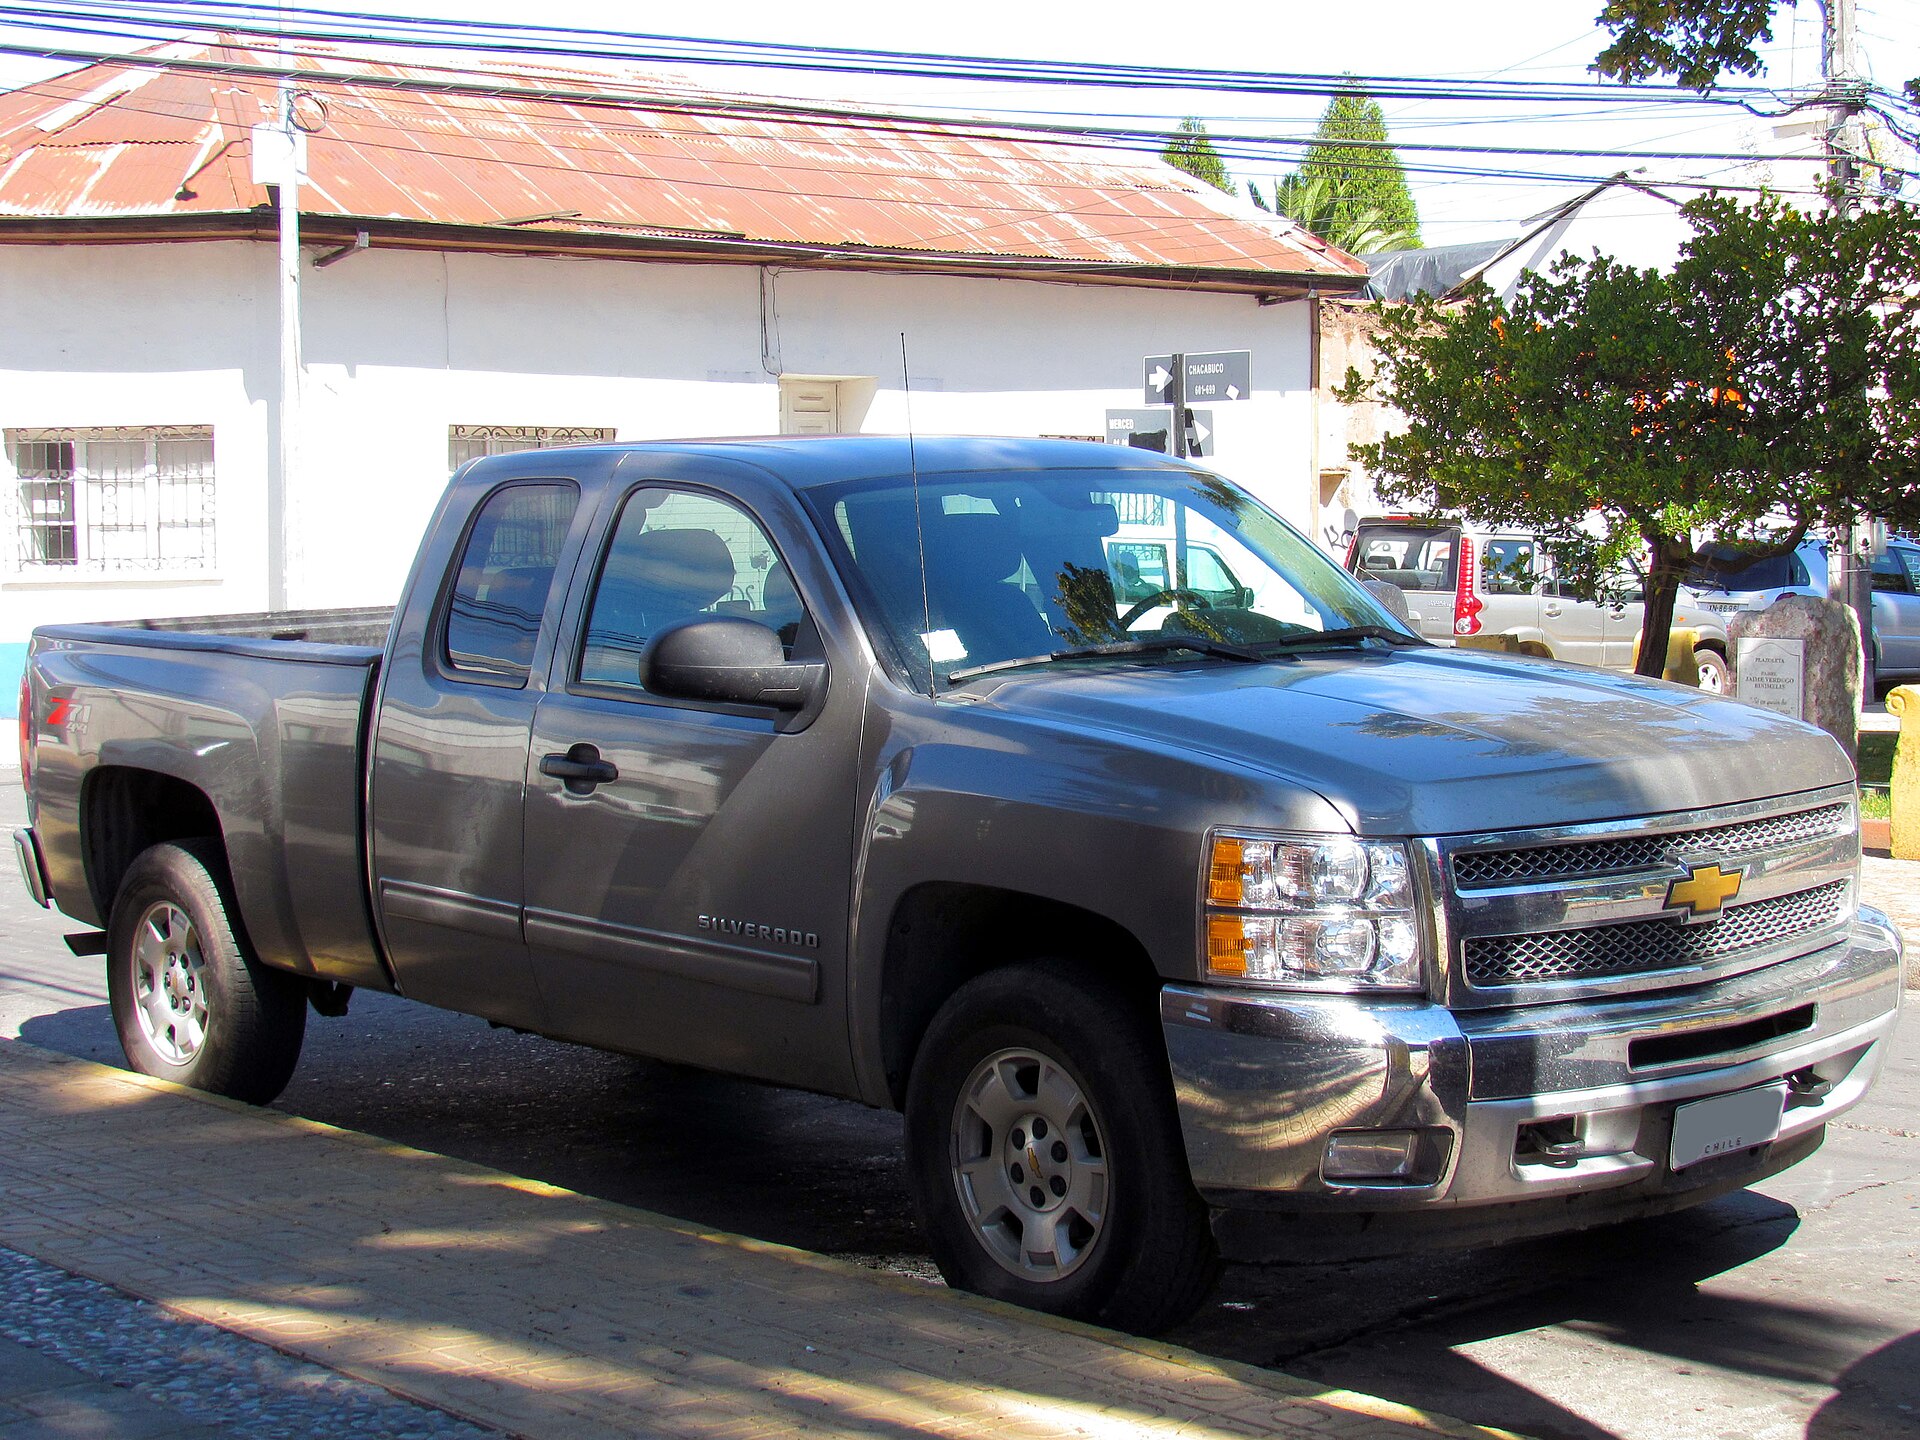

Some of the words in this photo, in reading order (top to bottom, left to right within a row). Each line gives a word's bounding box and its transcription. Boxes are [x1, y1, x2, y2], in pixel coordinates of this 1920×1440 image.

[1188, 362, 1224, 376] CHACABUCO
[1108, 418, 1135, 430] MERCED
[47, 697, 91, 725] Z71
[697, 914, 819, 948] SILVERADO
[1704, 1136, 1742, 1154] CHILE
